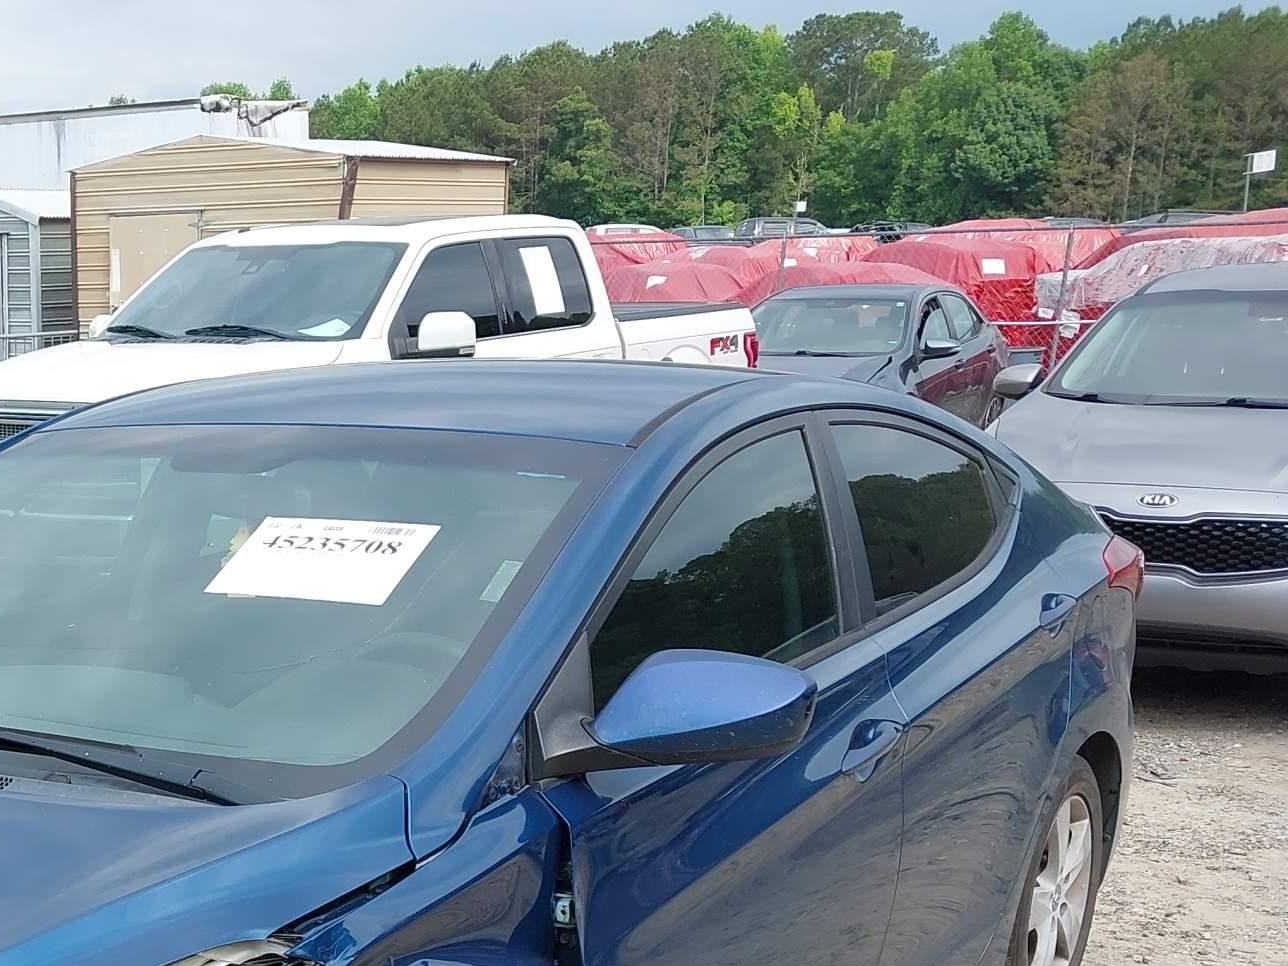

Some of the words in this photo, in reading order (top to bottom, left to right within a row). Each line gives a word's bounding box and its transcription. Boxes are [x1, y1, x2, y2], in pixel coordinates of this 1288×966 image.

[710, 334, 739, 356] FX4
[1142, 494, 1172, 505] KIA
[263, 535, 403, 555] 45235708
